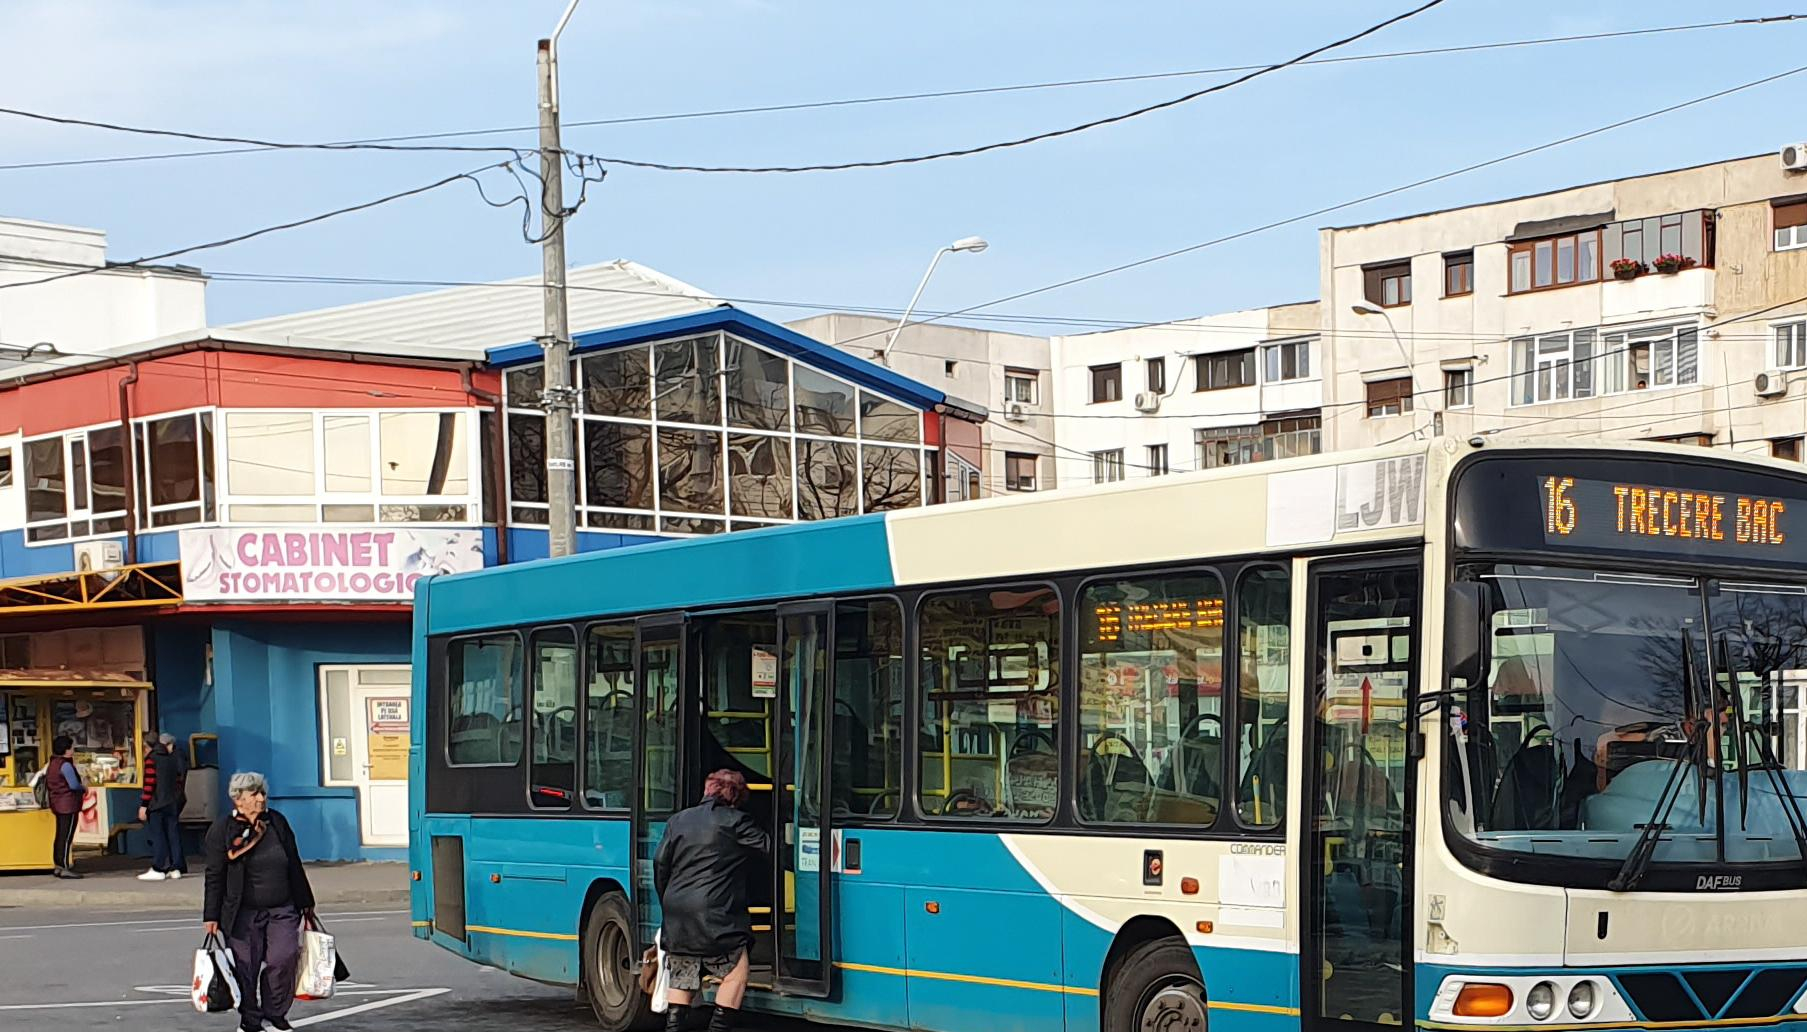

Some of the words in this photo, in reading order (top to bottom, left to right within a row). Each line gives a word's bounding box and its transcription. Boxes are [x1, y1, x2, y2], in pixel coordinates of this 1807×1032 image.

[1338, 456, 1424, 529] LJW
[1544, 476, 1577, 535] 16
[1614, 486, 1725, 541] TRECERE
[1736, 497, 1786, 545] BAC
[237, 532, 395, 567] CABINET
